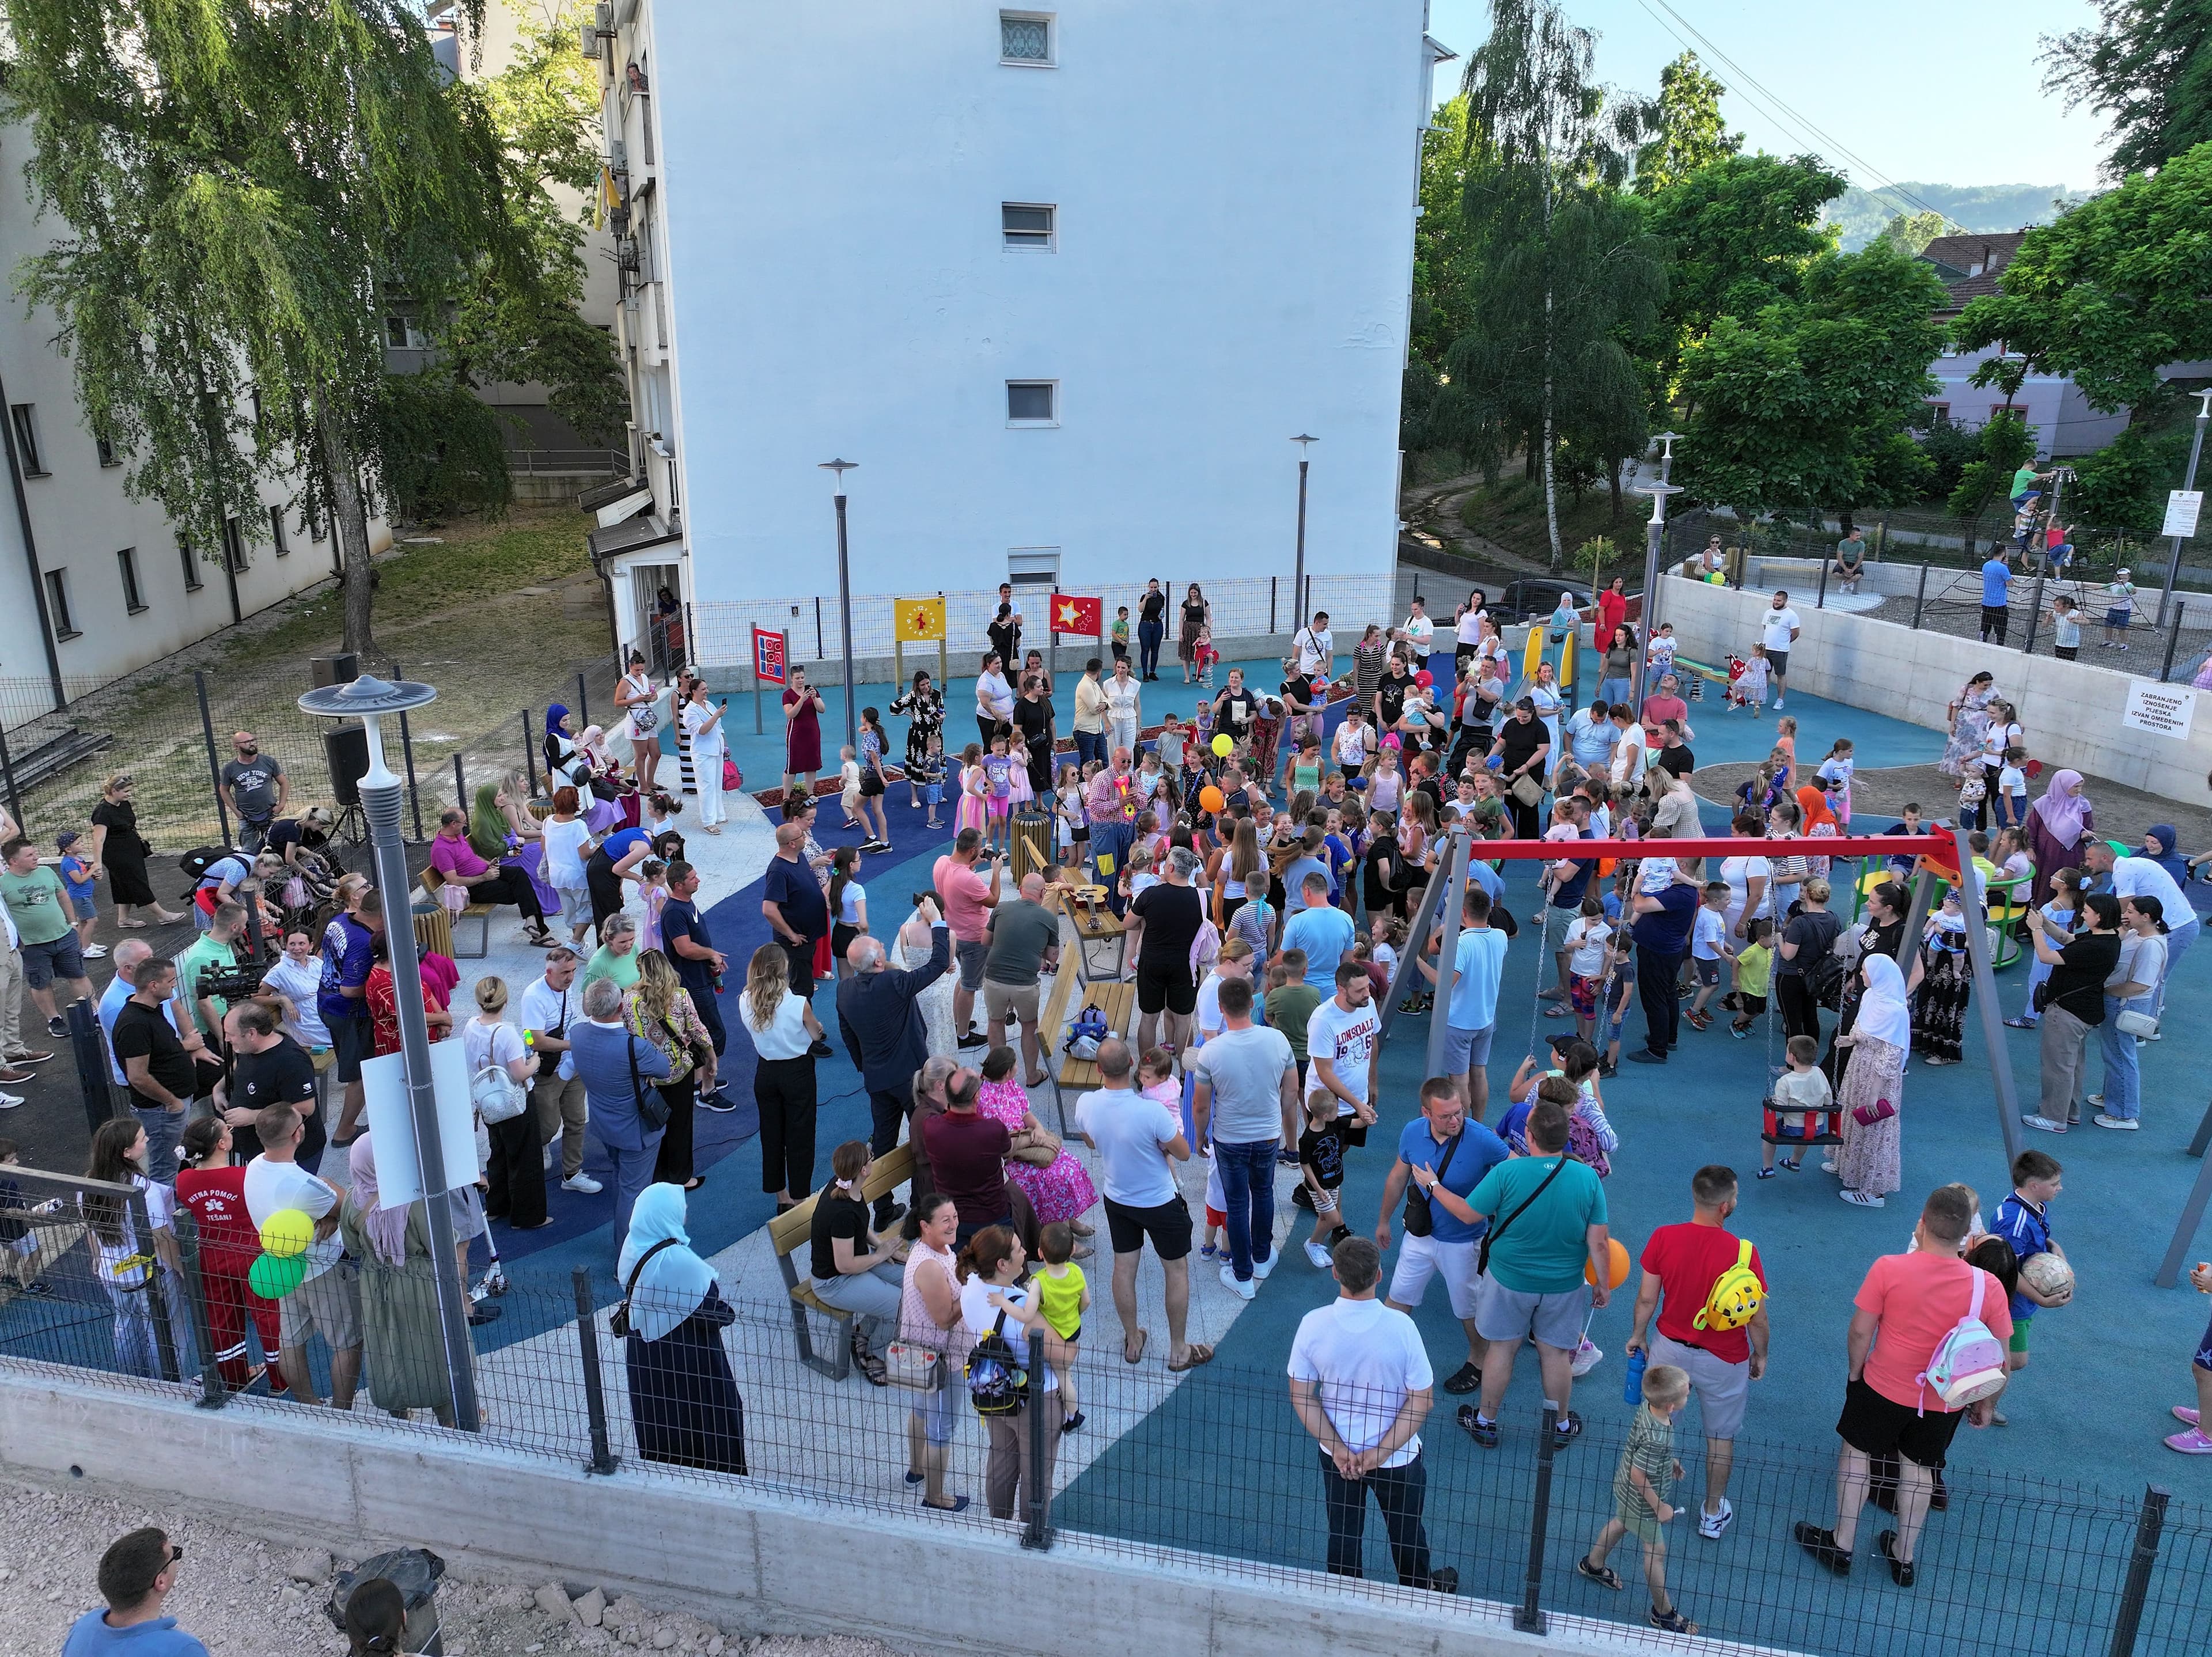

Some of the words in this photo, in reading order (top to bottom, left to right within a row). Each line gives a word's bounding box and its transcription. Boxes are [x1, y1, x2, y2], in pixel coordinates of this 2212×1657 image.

[2141, 692, 2182, 706] ZABRANJENO
[2142, 699, 2177, 711] IZNOŠENJE
[2131, 710, 2149, 719] IZVAN
[2145, 707, 2171, 717] PIJESKA
[2139, 719, 2172, 731] PROSTORA
[236, 771, 250, 782] NEW
[251, 770, 268, 778] YORK
[1336, 1018, 1374, 1045] LONSDALE
[1336, 1045, 1348, 1060] 19
[188, 1190, 209, 1204] HITNA
[210, 1189, 238, 1201] POMOĆ
